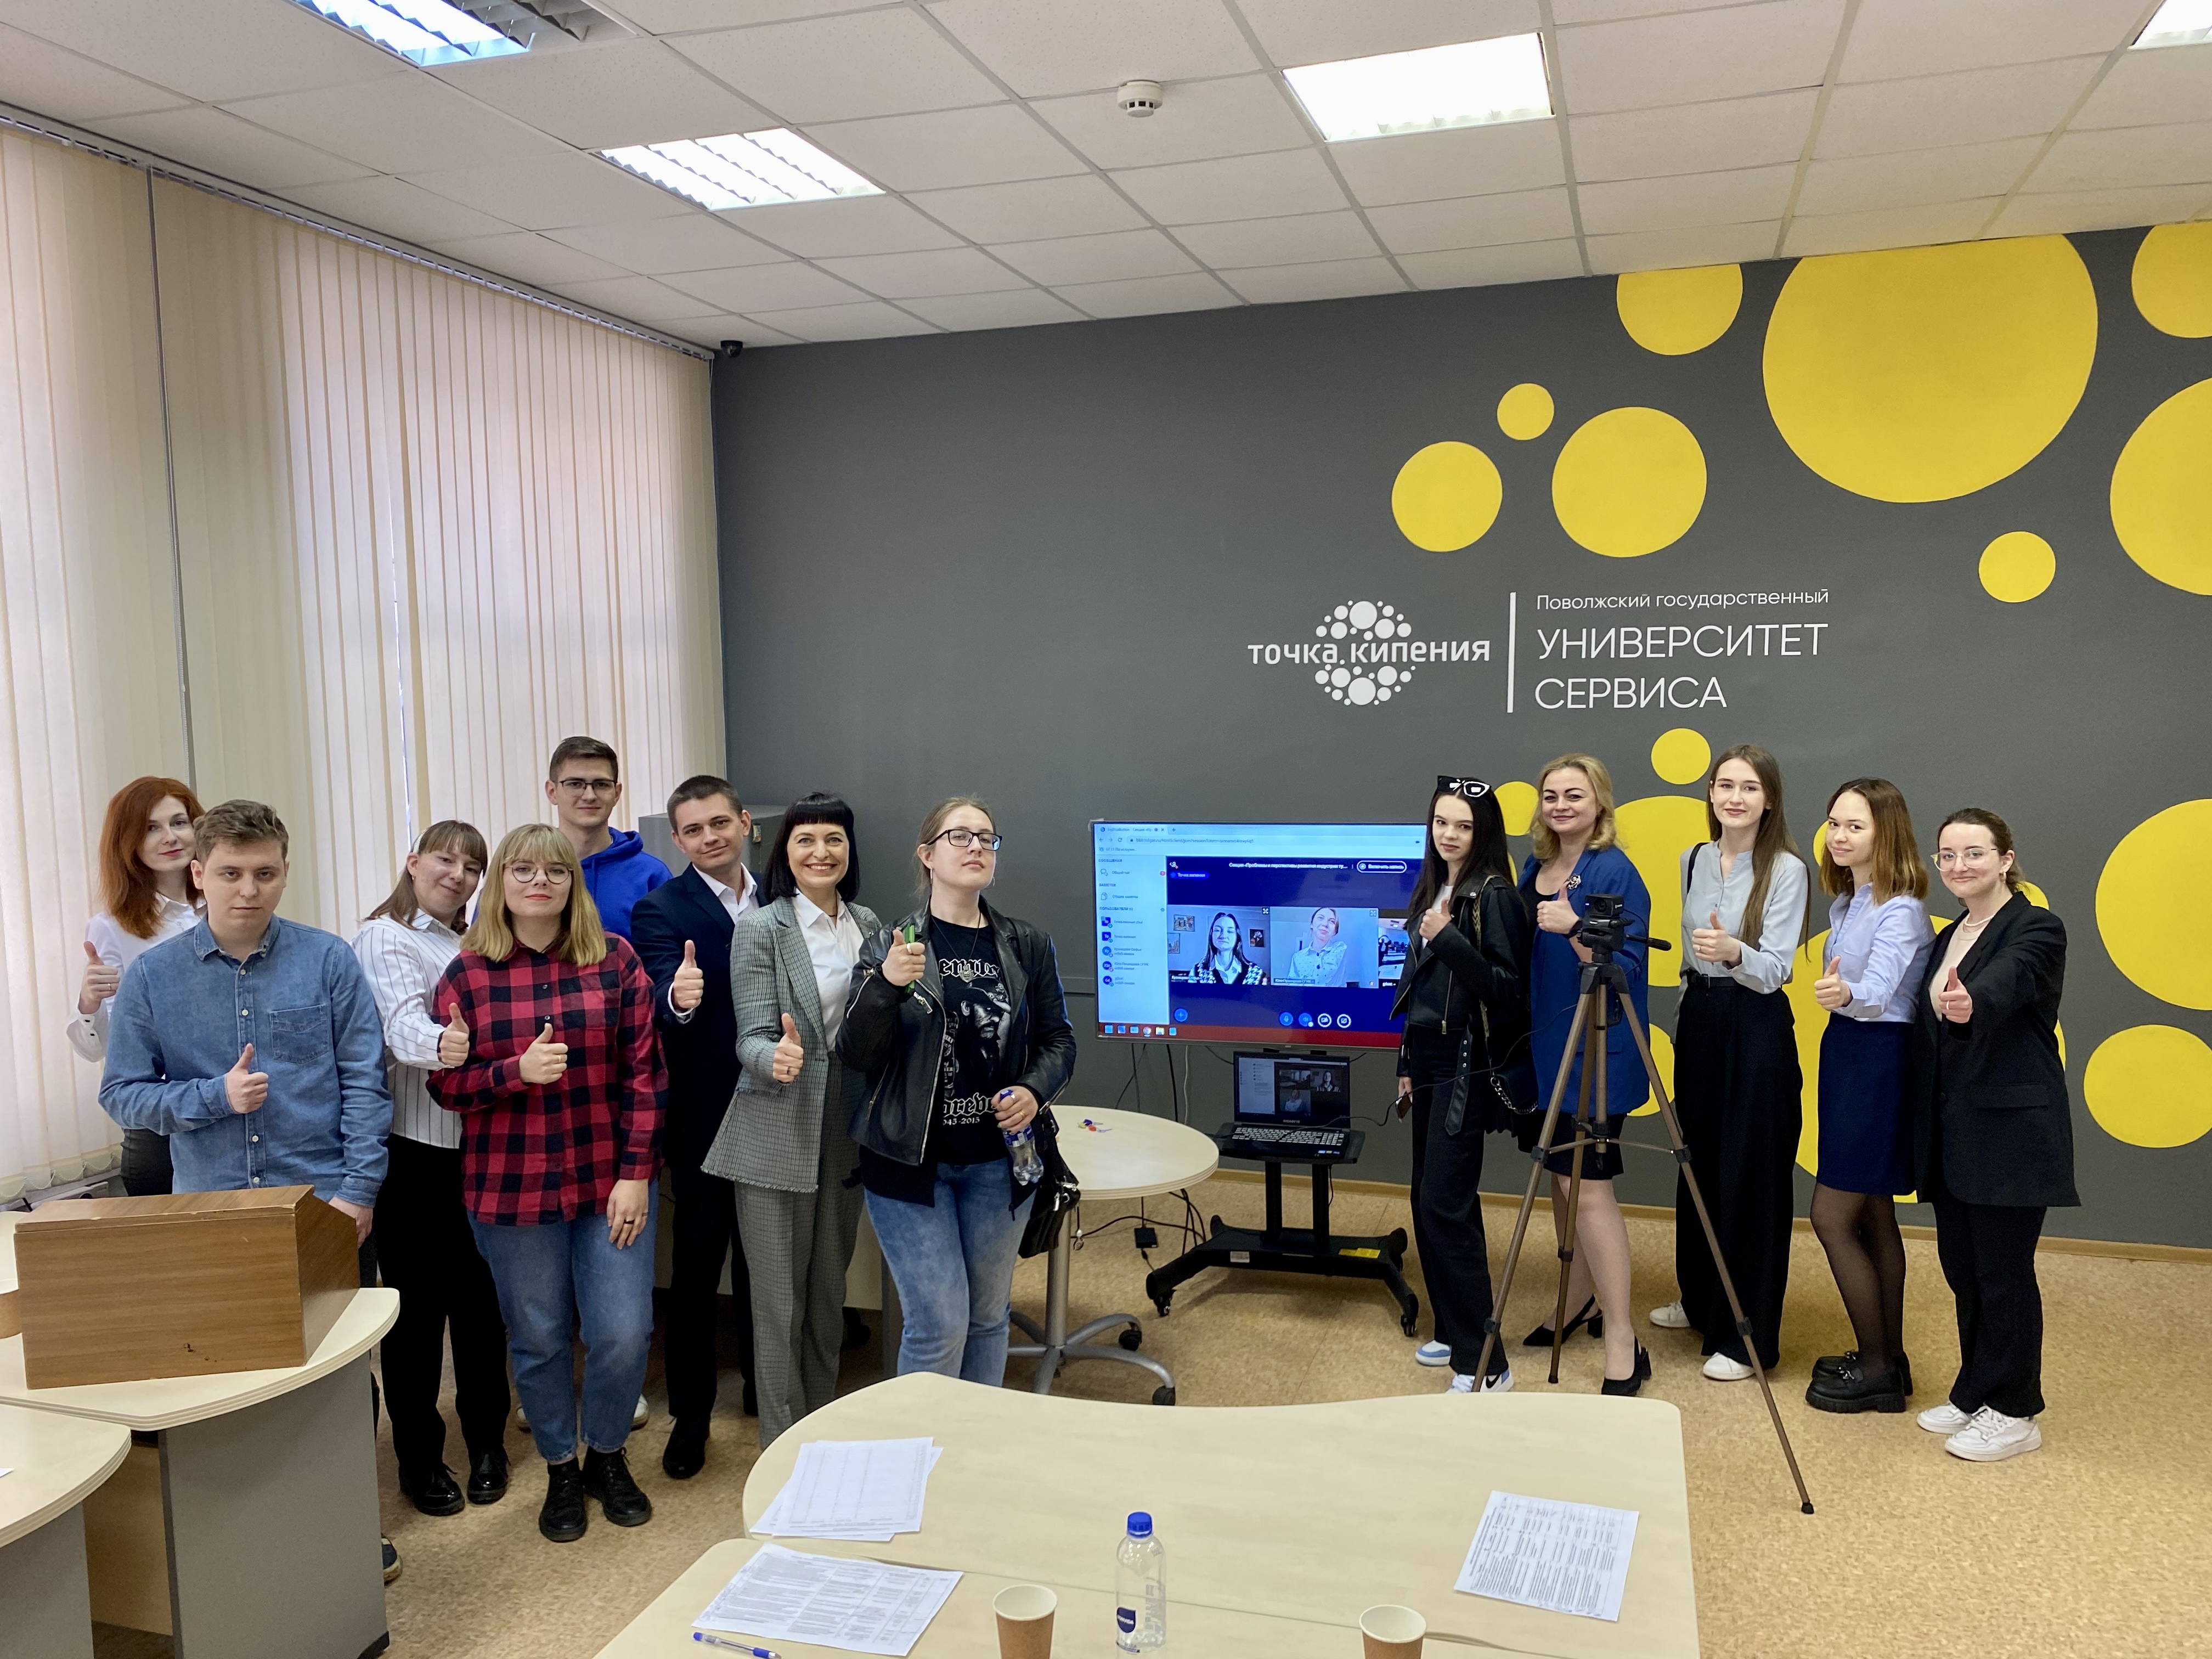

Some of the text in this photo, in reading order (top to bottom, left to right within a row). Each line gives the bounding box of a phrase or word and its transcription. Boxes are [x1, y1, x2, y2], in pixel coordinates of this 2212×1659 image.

[1537, 589, 1829, 610] Поволжский государственный
[1247, 640, 1490, 665] точка кипения
[1537, 623, 1829, 659] УНИВЕРСИТЕТ
[1535, 676, 1727, 709] СЕРВИСА
